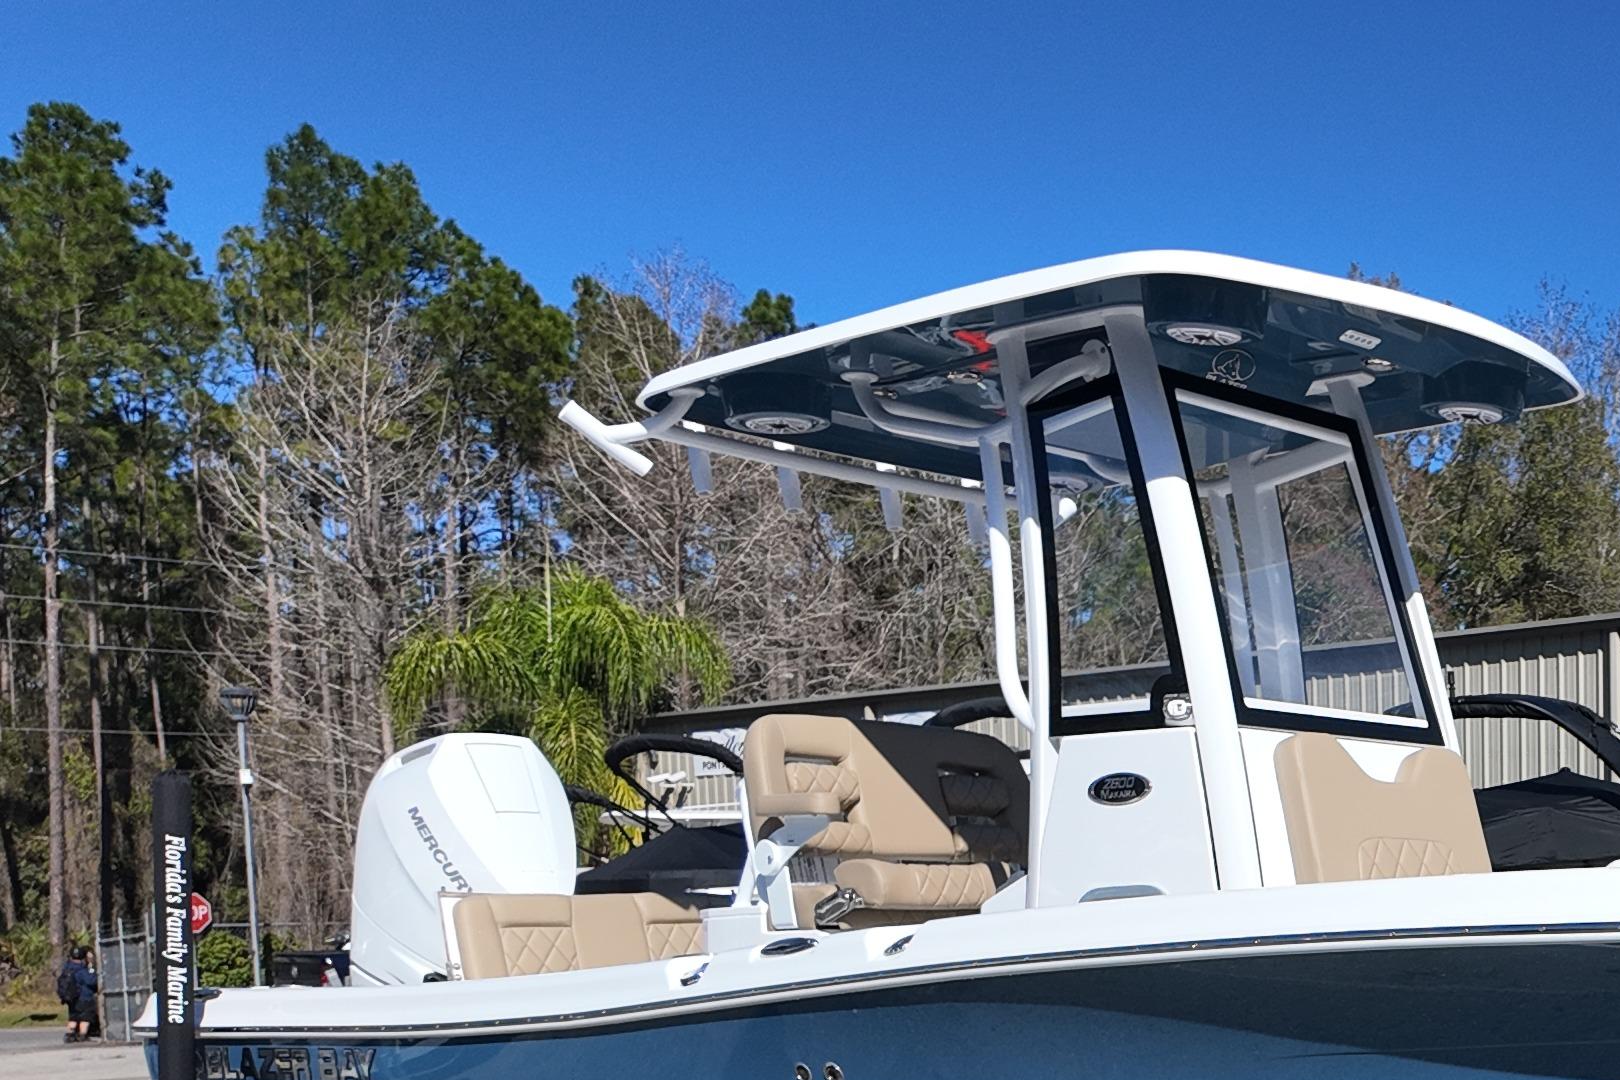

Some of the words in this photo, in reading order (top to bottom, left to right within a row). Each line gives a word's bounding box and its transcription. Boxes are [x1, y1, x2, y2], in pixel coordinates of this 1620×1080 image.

[164, 833, 187, 904] Florida's
[407, 806, 473, 893] MERCUR
[161, 907, 189, 964] Family
[192, 904, 209, 920] OP
[167, 964, 190, 1025] Marine
